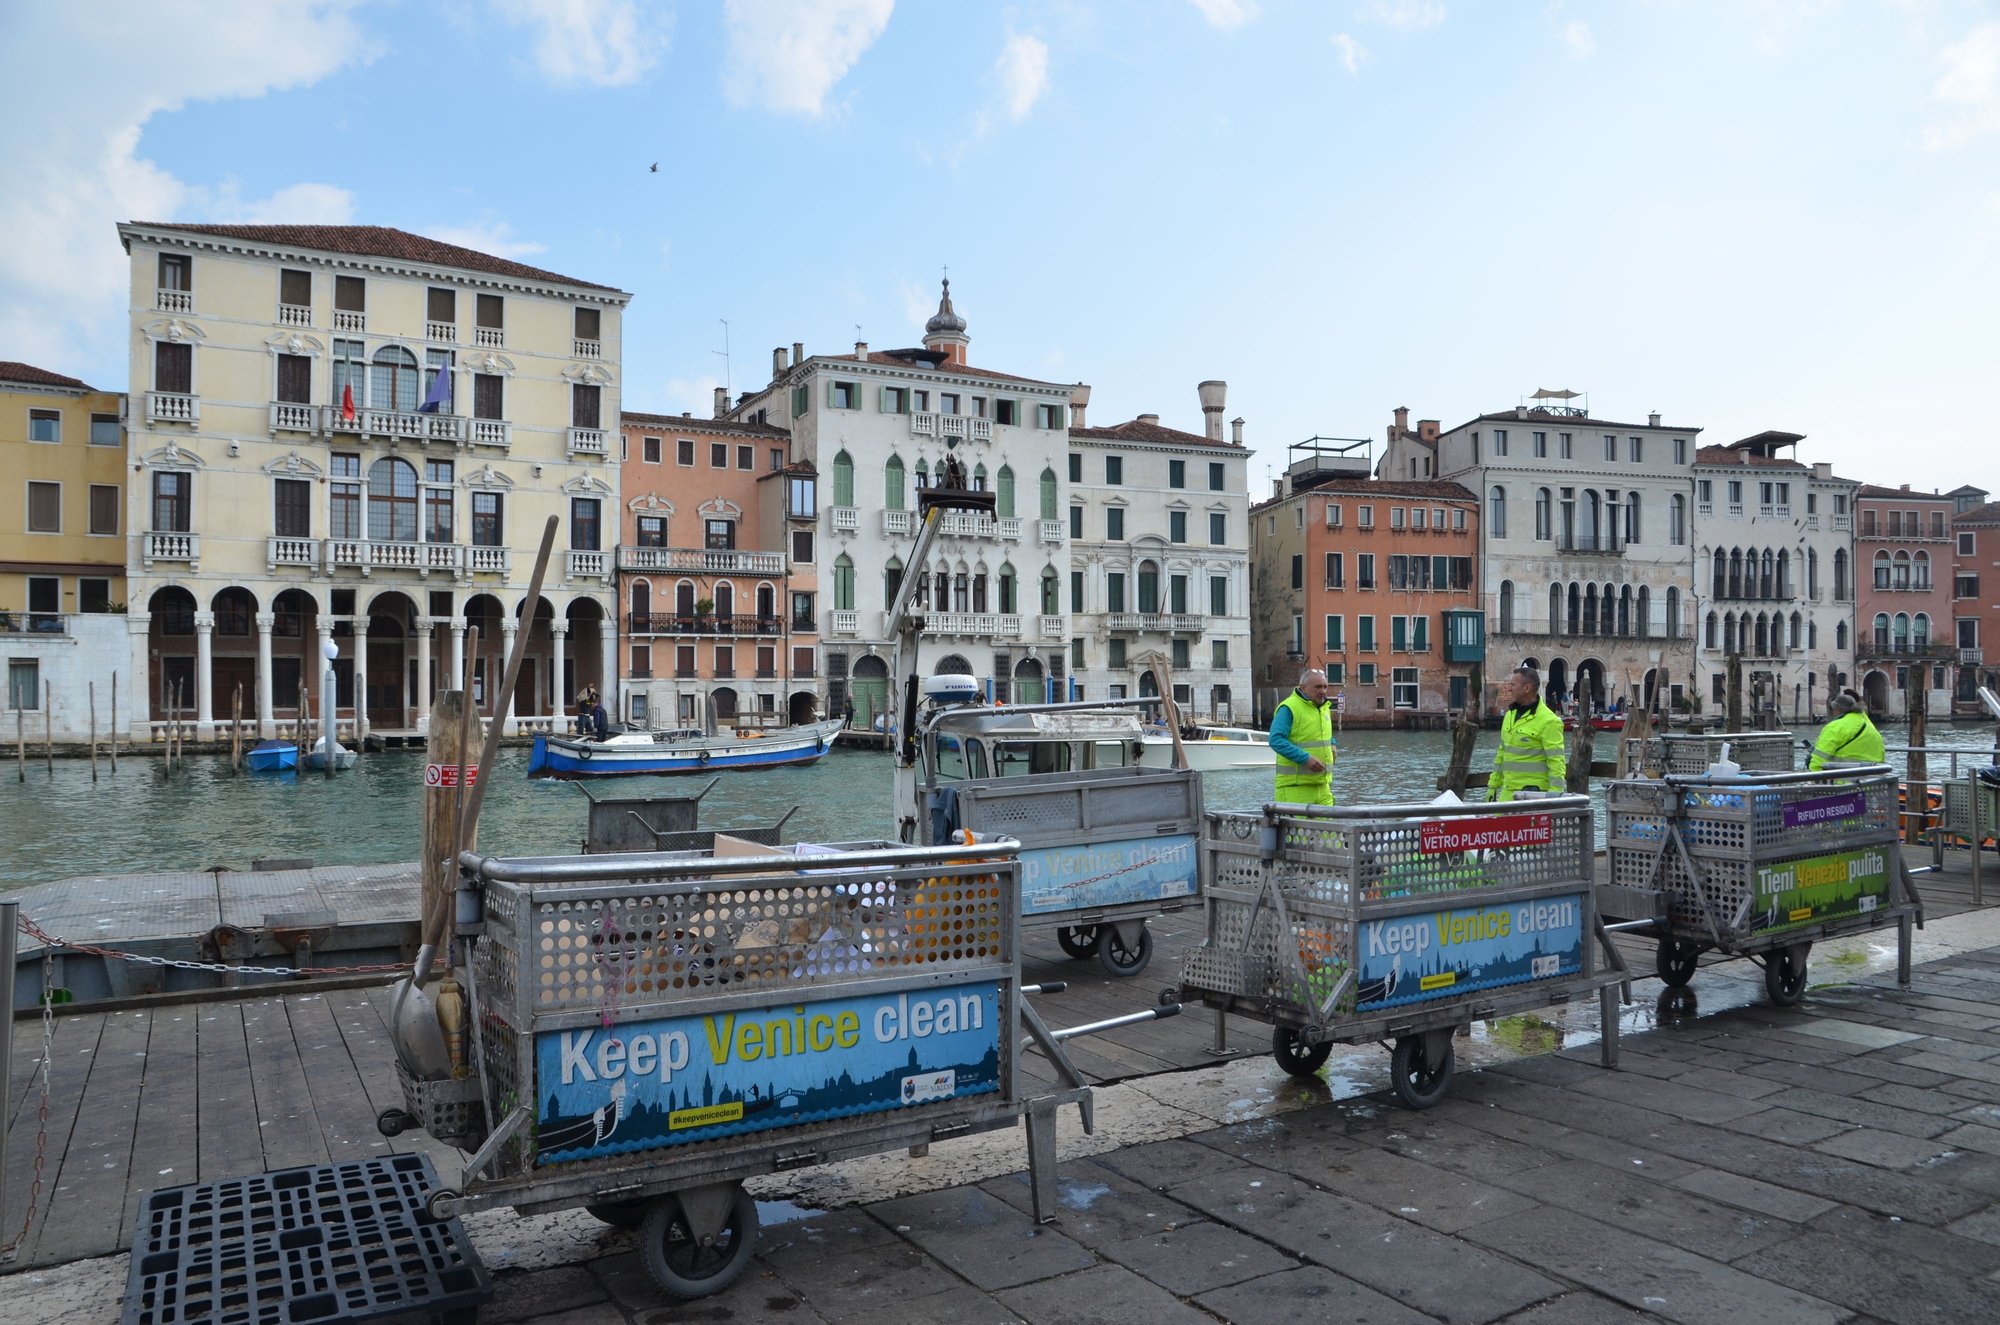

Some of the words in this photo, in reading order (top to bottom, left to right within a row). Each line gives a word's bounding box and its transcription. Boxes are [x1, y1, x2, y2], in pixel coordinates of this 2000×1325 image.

[1797, 808, 1825, 822] RIFIUTO
[1826, 803, 1855, 817] RESIDUO
[1424, 834, 1459, 849] VETRO
[1461, 830, 1510, 846] PLASTICA
[1511, 827, 1549, 842] LATTINE
[1045, 848, 1122, 880] Venice
[1129, 843, 1188, 869] clean
[1758, 865, 1794, 895] Tieni
[1796, 859, 1847, 889] Venezia
[1849, 852, 1883, 883] pulita
[1368, 920, 1430, 957] Keep
[1436, 904, 1511, 947] Venice
[1517, 900, 1573, 934] clean
[560, 1029, 690, 1085] Keep
[703, 1005, 861, 1066] Venice
[873, 992, 983, 1043] clean
[673, 1108, 739, 1125] #keepveniceclean
